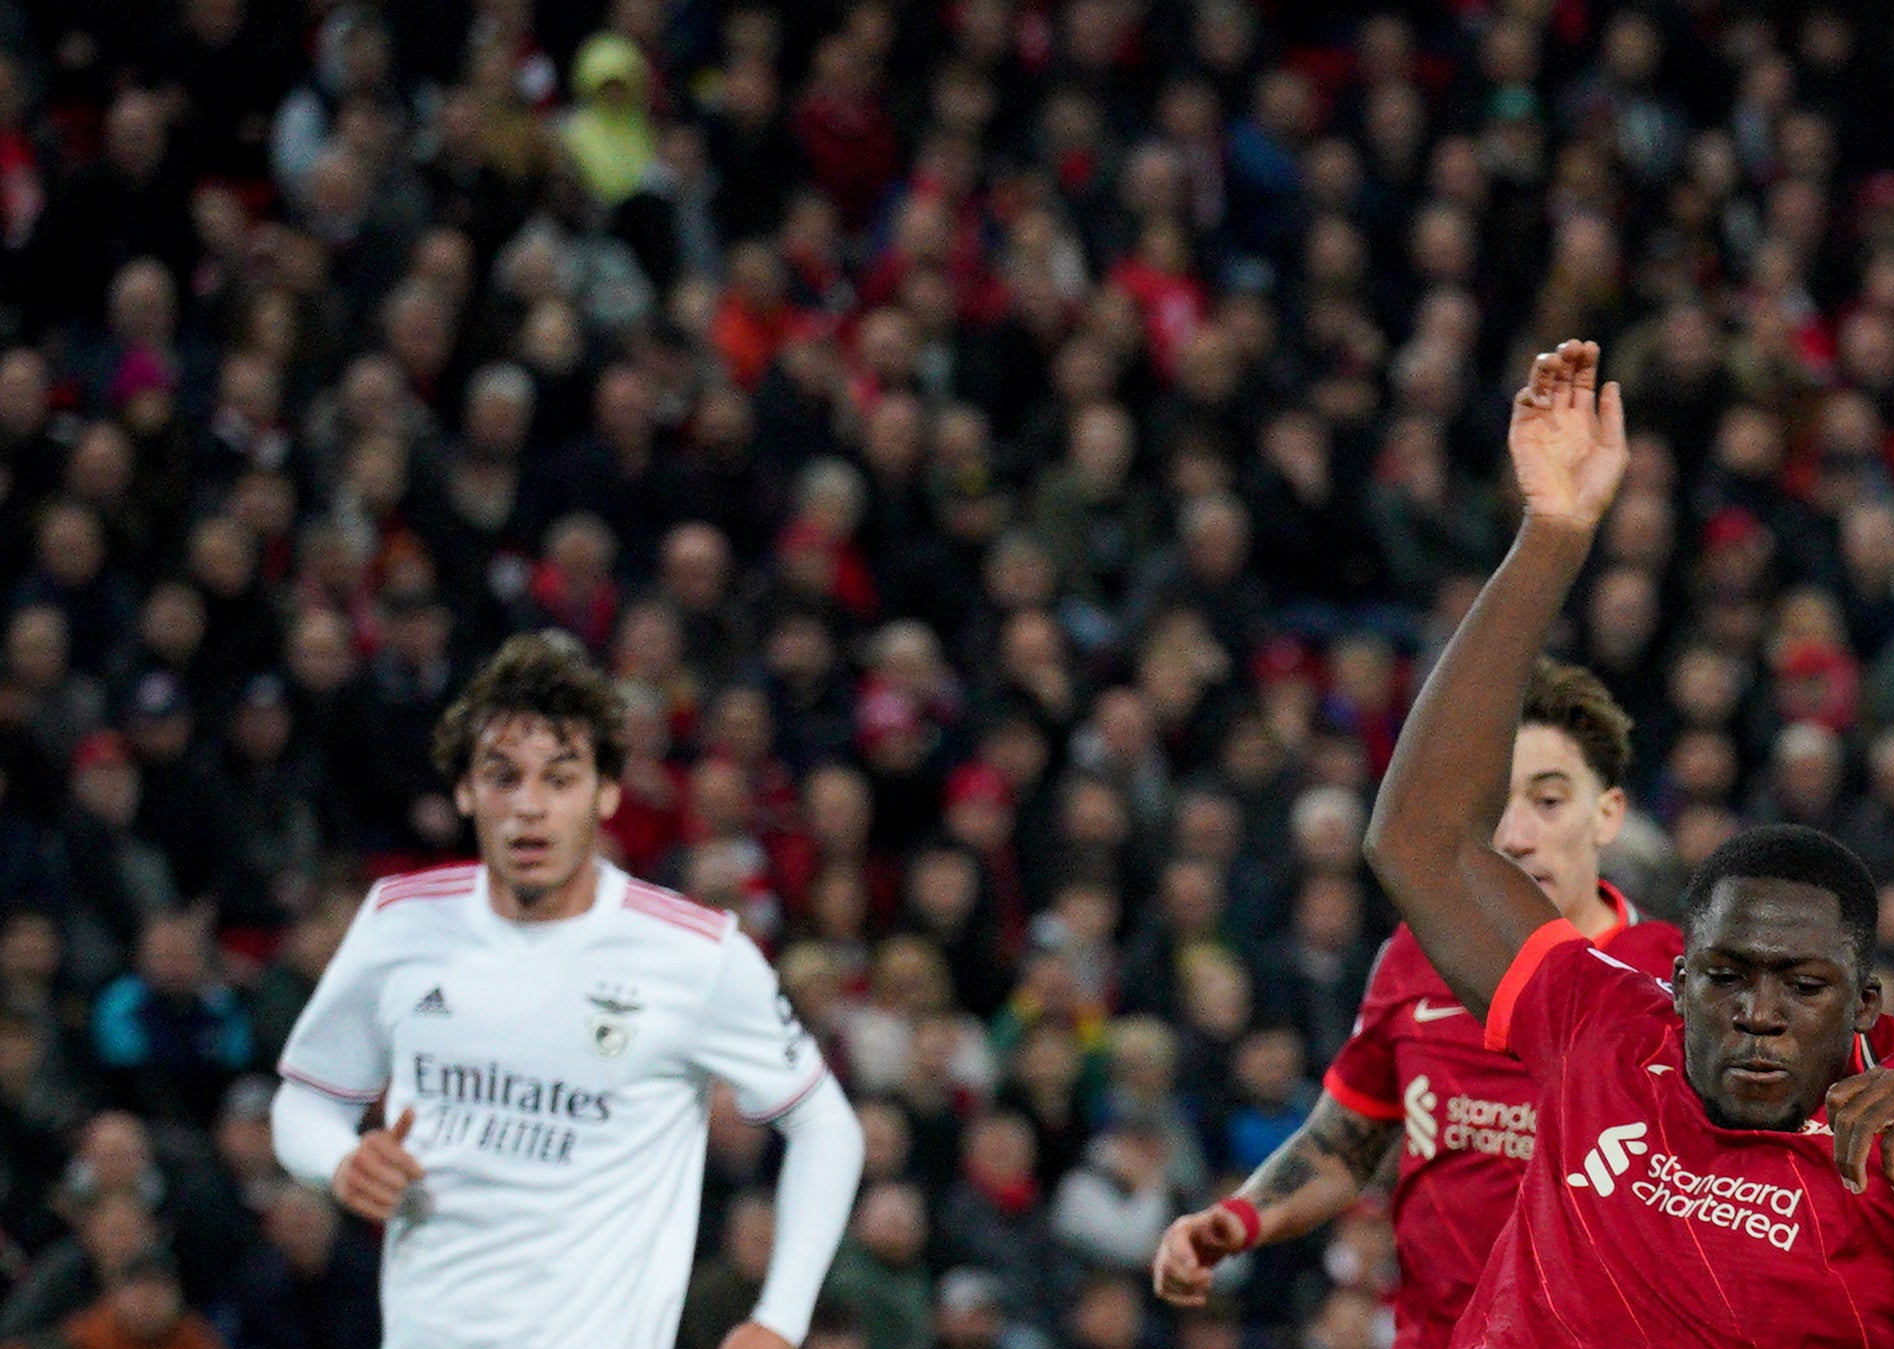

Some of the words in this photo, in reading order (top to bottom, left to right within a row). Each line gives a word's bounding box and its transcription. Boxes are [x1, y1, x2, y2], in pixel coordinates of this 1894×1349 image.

[414, 1052, 610, 1122] Emirates
[478, 1113, 577, 1165] BETTER
[1631, 1181, 1799, 1252] chartered
[1648, 1153, 1803, 1218] standard
